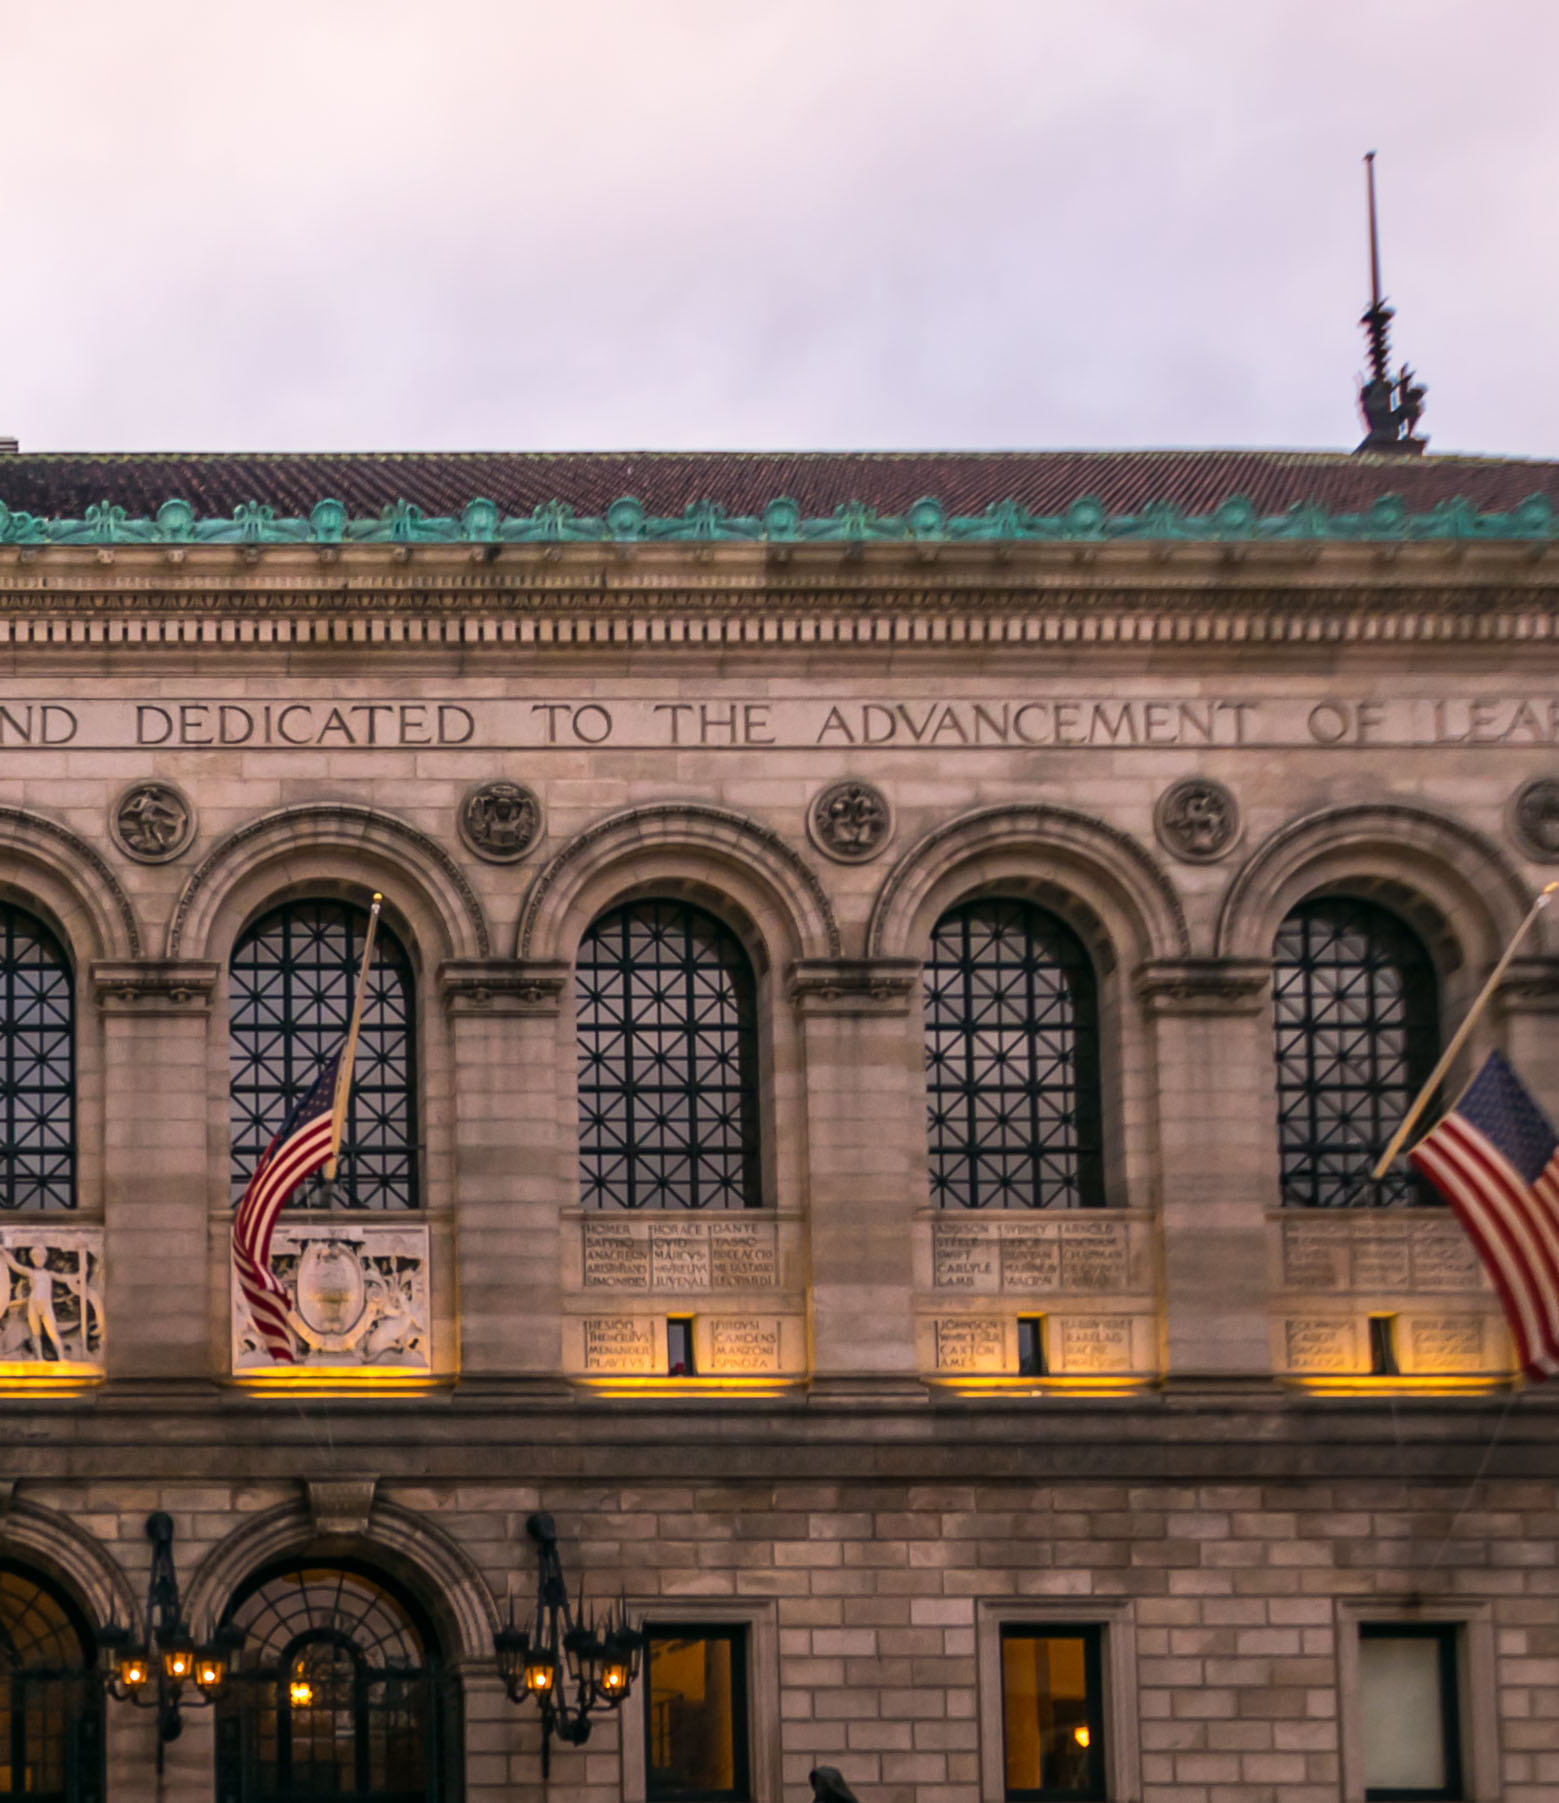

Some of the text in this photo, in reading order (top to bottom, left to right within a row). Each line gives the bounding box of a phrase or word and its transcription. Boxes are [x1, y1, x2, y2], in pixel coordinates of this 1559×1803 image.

[134, 702, 476, 746] DEDICATED
[531, 702, 614, 746] TO
[653, 702, 777, 746] THE
[815, 702, 1258, 746] ADVANCEMENT
[1306, 702, 1385, 746] OF
